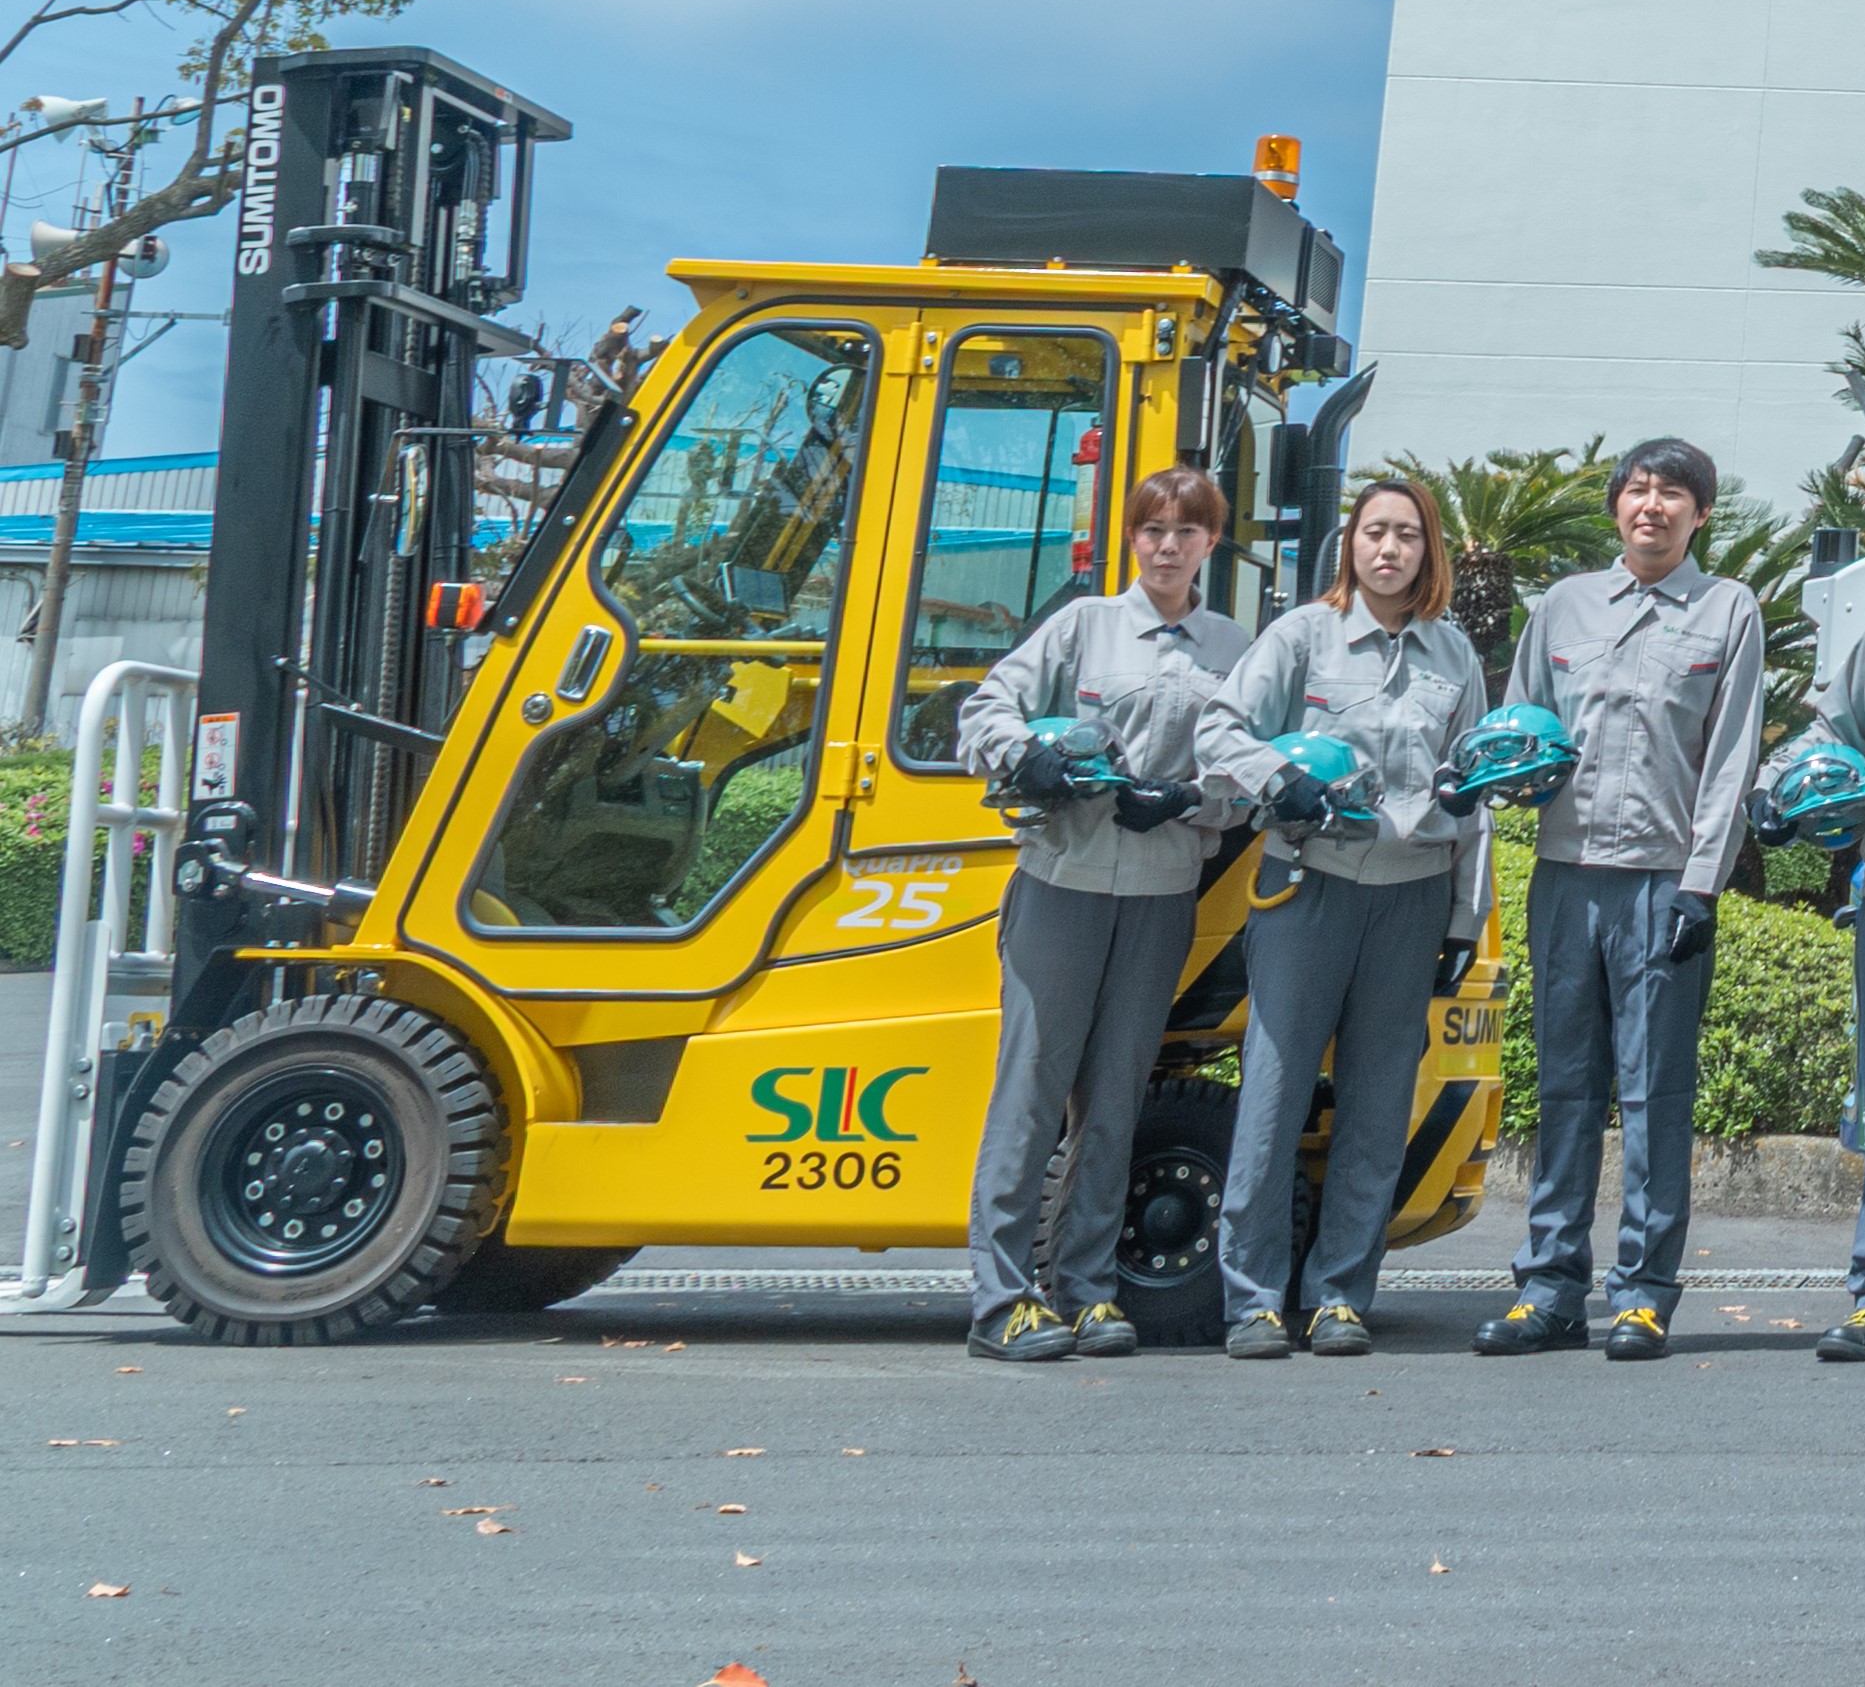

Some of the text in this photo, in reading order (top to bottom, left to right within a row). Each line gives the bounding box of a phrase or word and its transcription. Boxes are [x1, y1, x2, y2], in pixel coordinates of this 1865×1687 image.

[238, 84, 286, 275] SUMITOMO
[836, 880, 949, 929] 25
[760, 1151, 902, 1191] 2306
